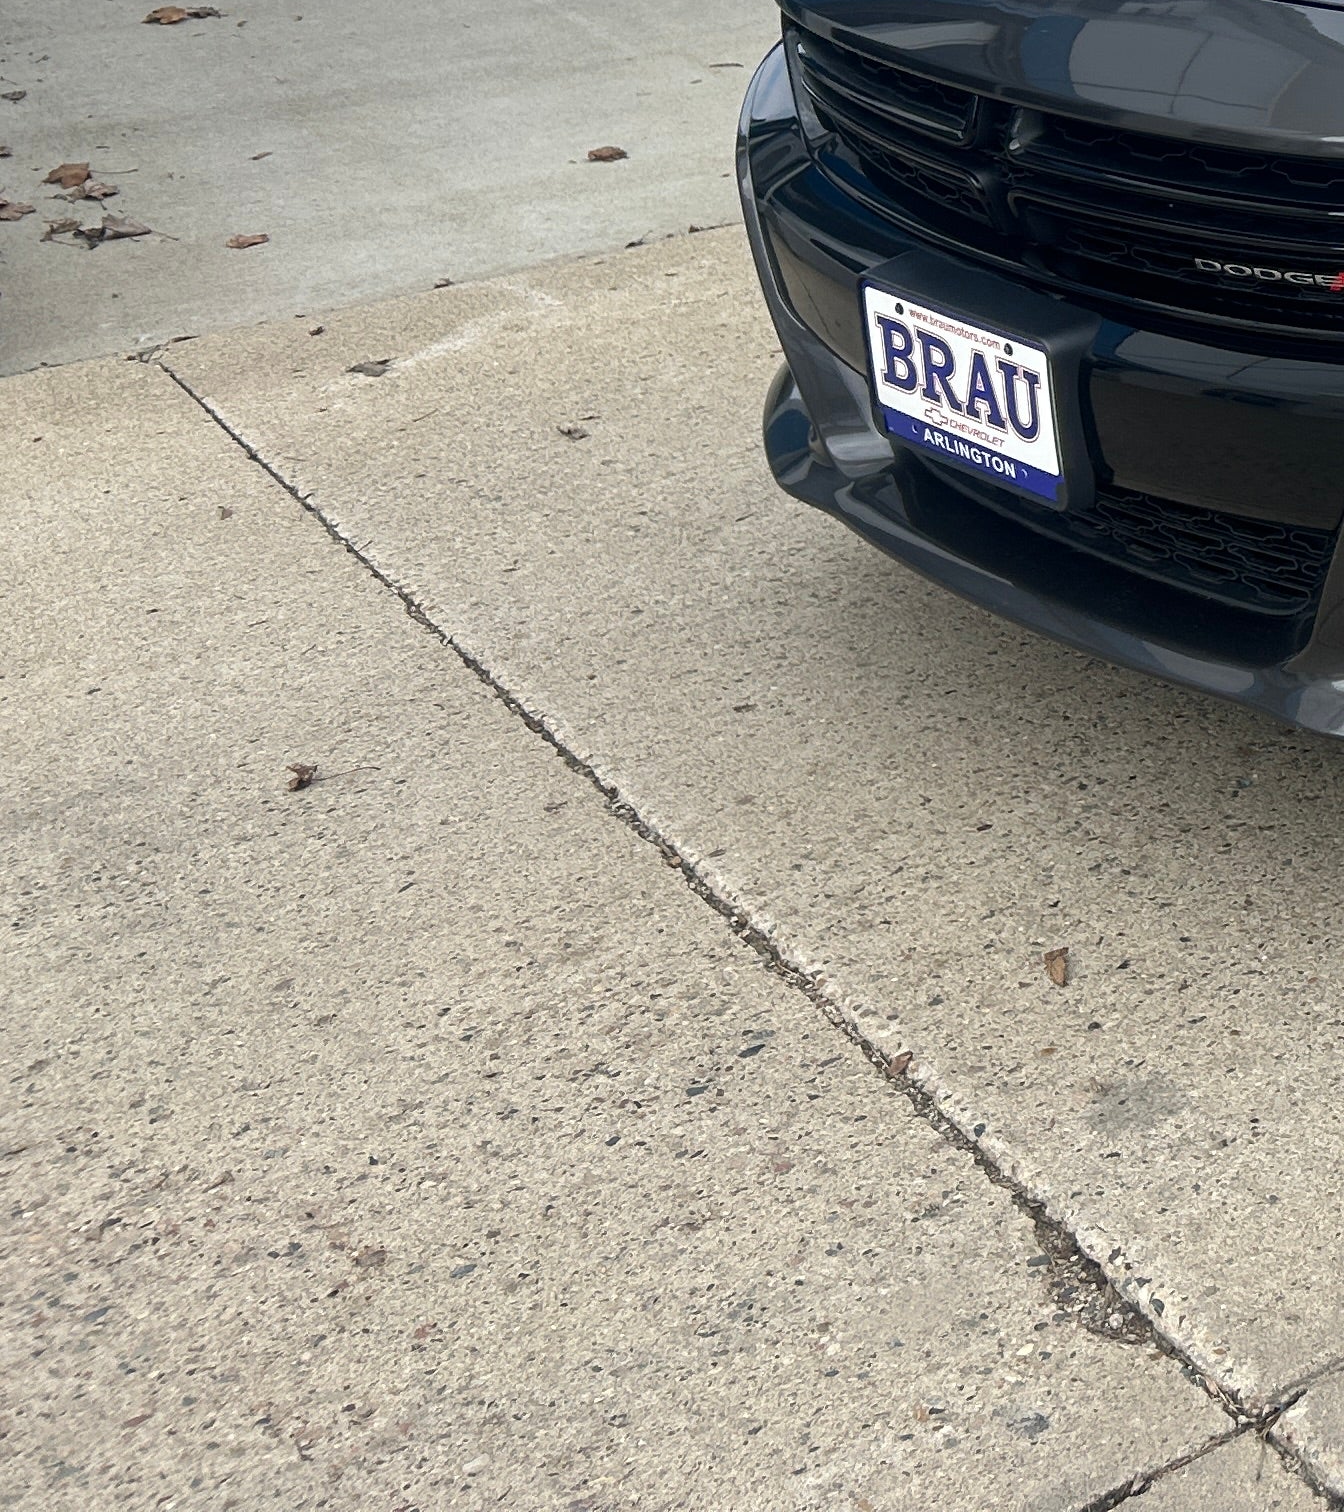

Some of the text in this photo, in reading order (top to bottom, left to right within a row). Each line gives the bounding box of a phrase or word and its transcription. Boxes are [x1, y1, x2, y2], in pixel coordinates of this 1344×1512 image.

[1194, 257, 1344, 288] DODGE
[908, 308, 1001, 350] www.braumotors.com
[874, 311, 1042, 444] BRAU
[923, 427, 1017, 479] ARLINGTON
[950, 419, 1006, 449] CHEVROLET
